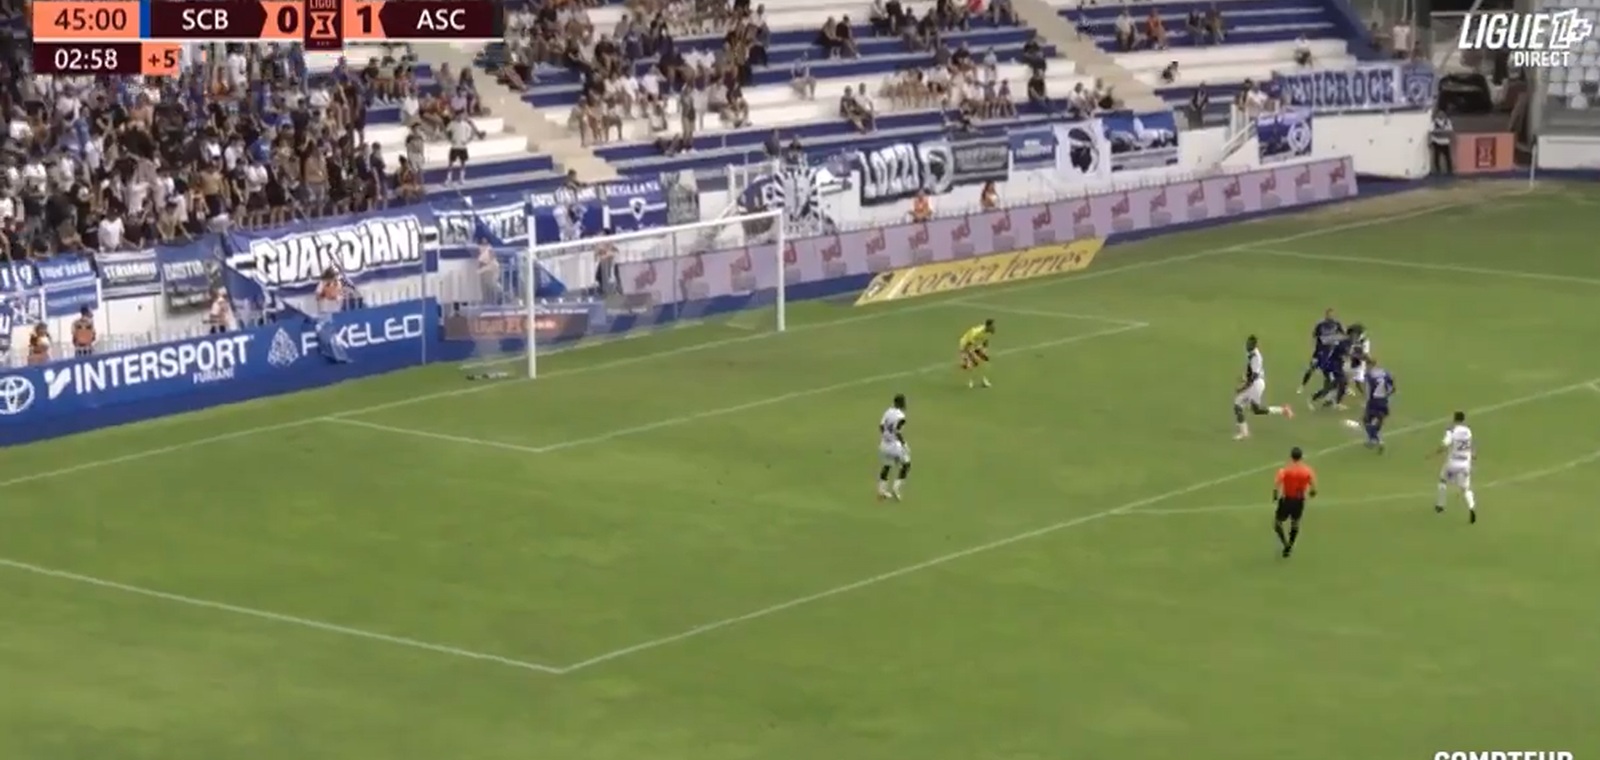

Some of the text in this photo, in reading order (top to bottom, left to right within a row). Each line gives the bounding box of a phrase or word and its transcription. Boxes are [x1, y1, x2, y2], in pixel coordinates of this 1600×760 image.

[251, 215, 422, 287] GUARDIANI
[902, 243, 1090, 295] corsica ferries
[75, 335, 250, 395] INTERSPORT
